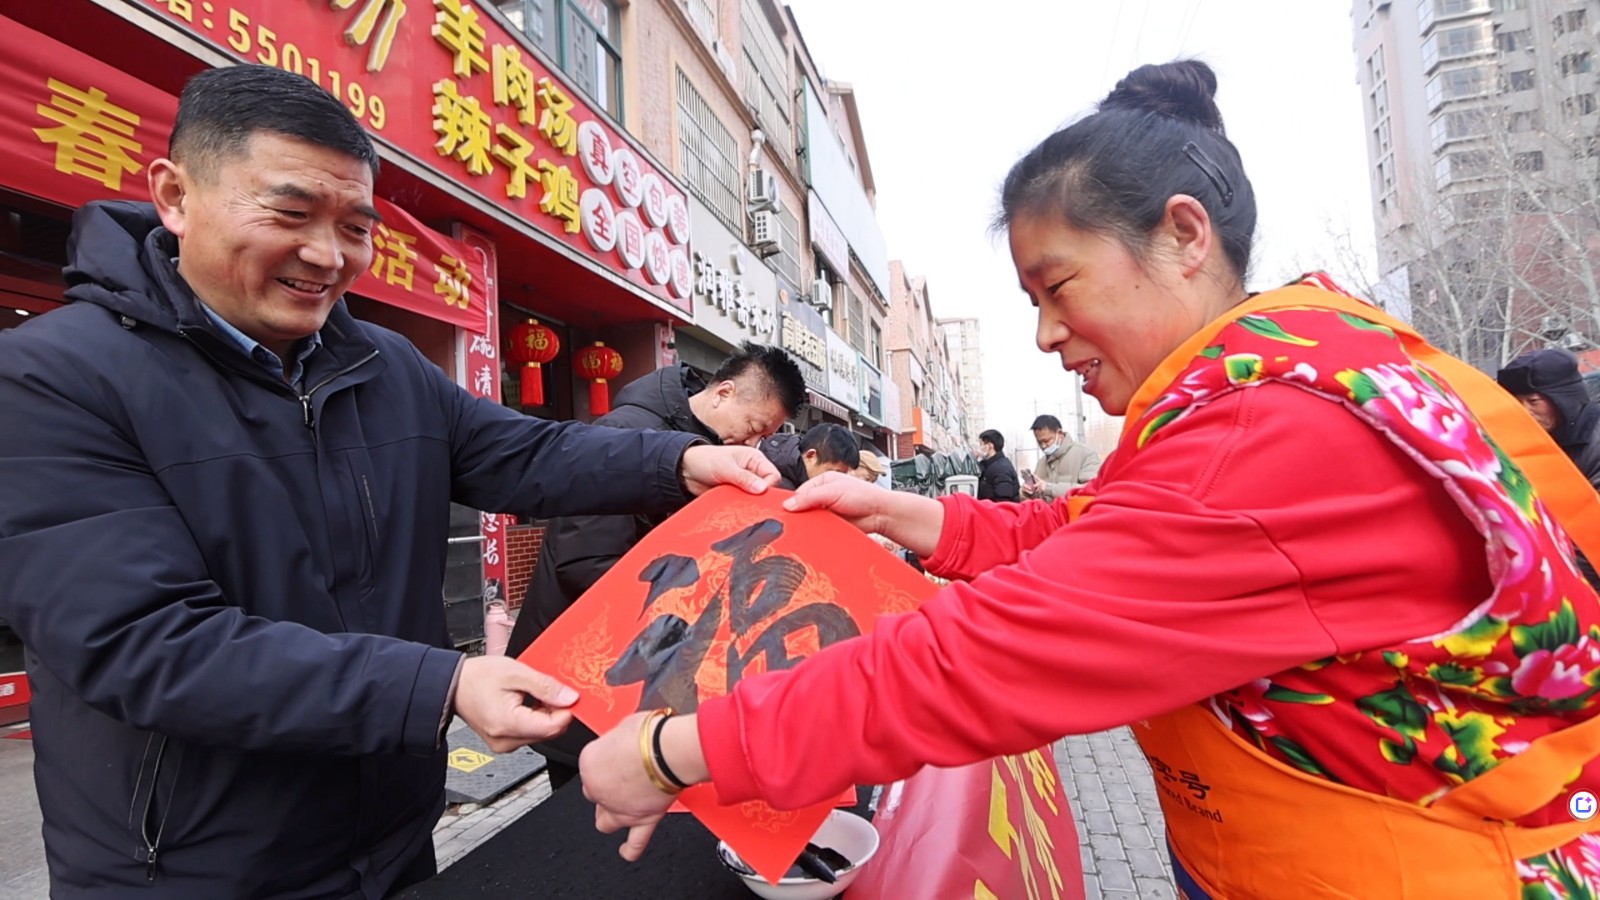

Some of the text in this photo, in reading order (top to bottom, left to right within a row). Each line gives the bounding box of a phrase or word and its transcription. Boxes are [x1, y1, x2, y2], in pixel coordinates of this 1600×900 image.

[432, 0, 577, 157] 羊肉汤
[433, 78, 580, 234] 辣子鸡
[32, 77, 143, 191] 春
[370, 222, 472, 310] 活动
[605, 518, 861, 711] 福
[1183, 797, 1223, 823] Brand
